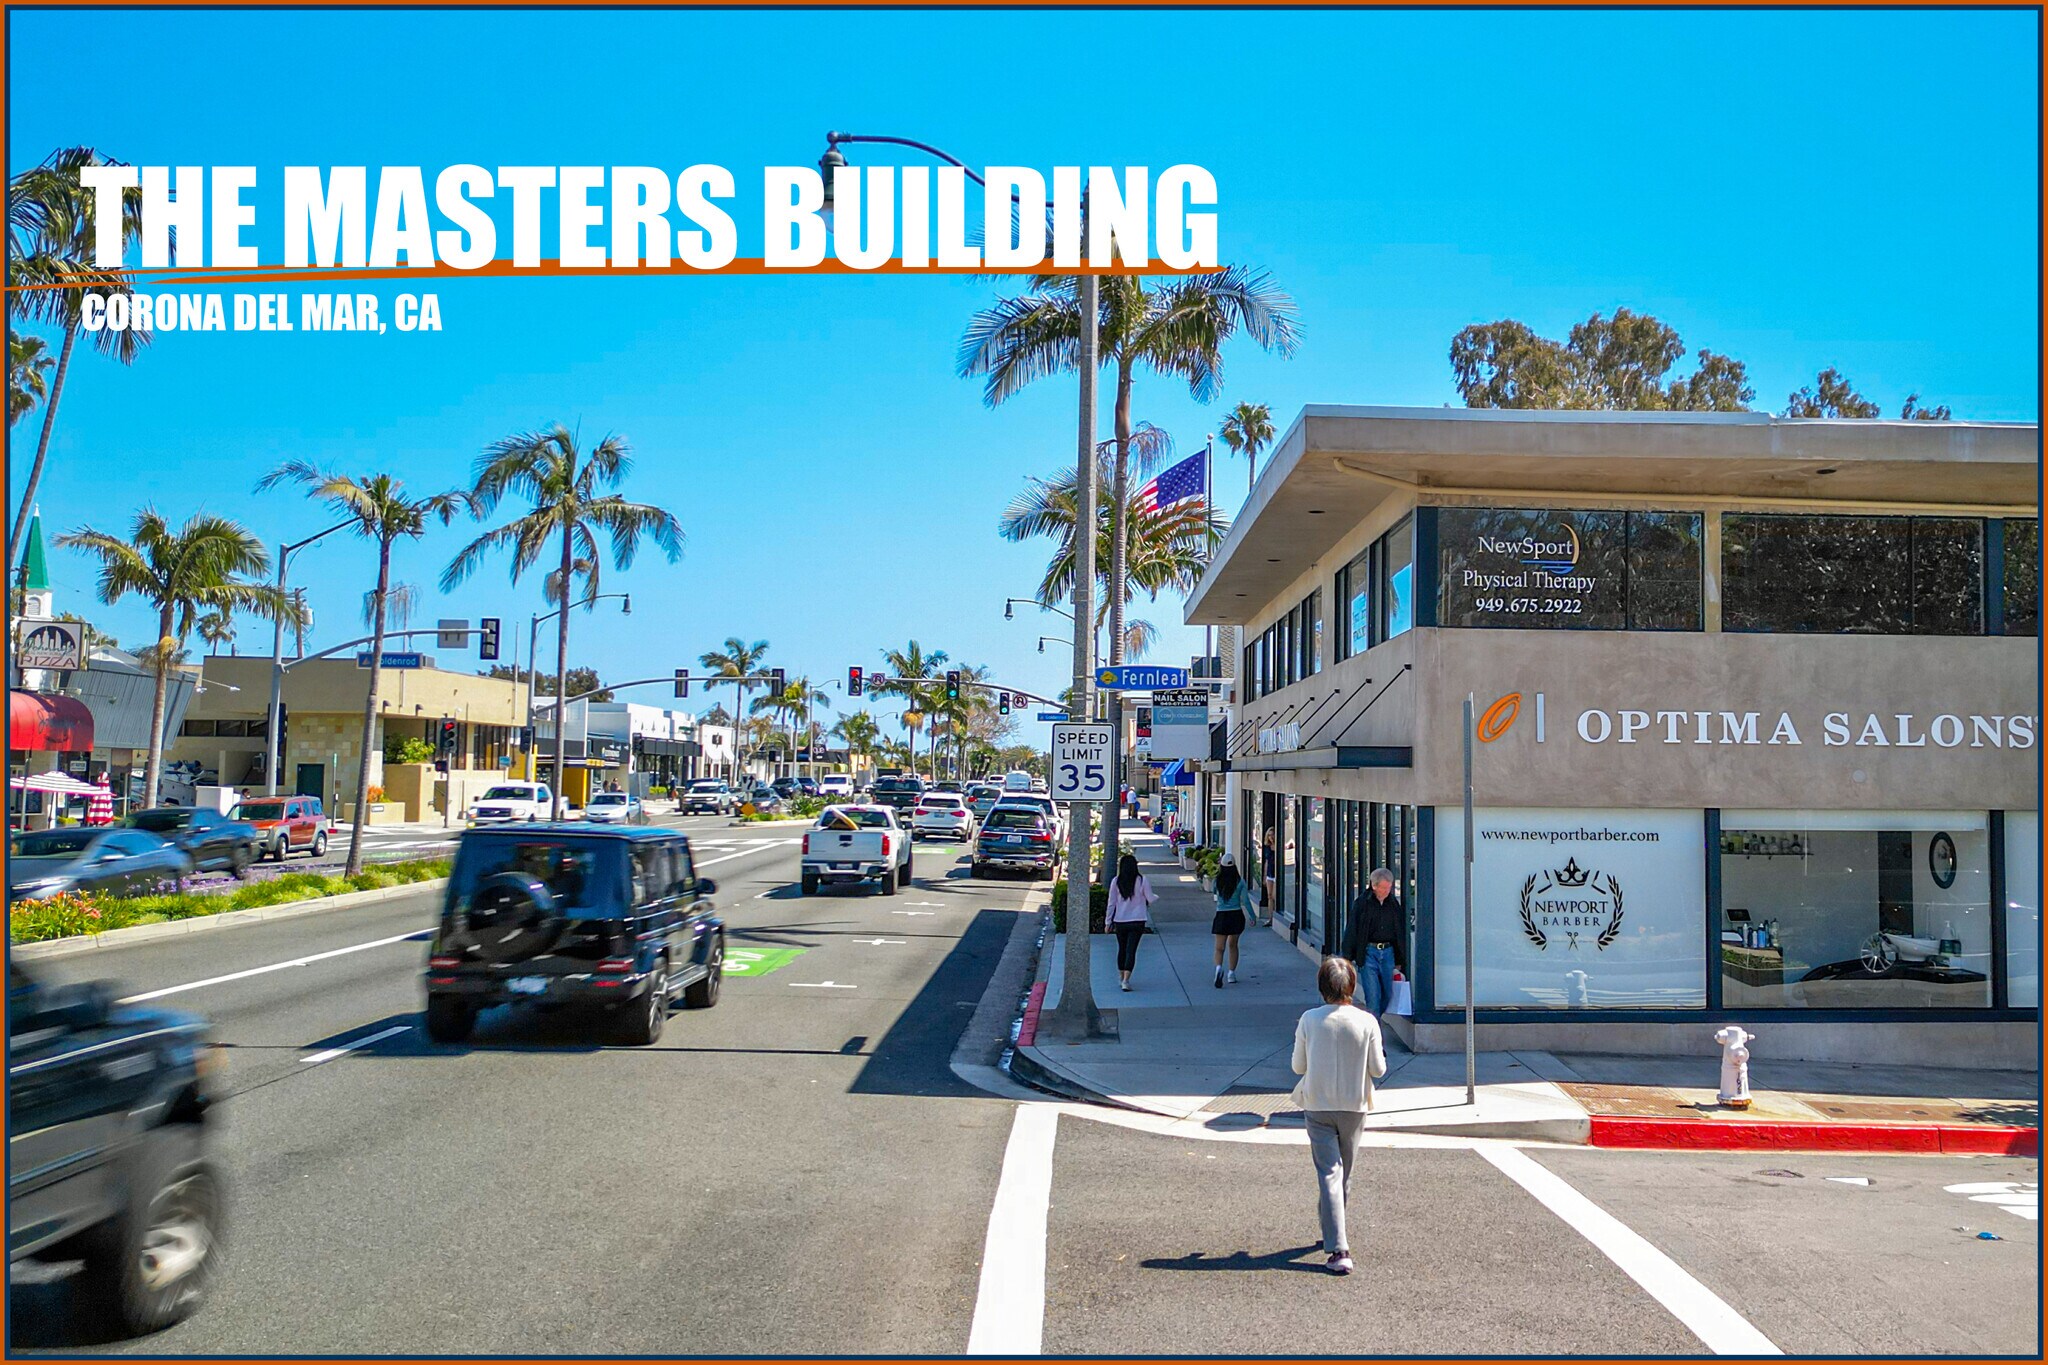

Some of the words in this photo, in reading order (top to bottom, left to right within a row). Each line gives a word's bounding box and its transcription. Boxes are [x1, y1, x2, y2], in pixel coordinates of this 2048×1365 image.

[1478, 537, 1573, 559] NewSport
[1463, 570, 1528, 591] Physical
[1533, 571, 1596, 593] Therapy
[1476, 598, 1582, 613] 949.675.2922
[20, 655, 76, 668] PIZZA
[379, 656, 417, 666] oldenrod
[1122, 669, 1185, 686] Fernleaf
[1154, 694, 1175, 702] NAIL
[1177, 694, 1207, 702] SALON
[1576, 709, 1803, 745] OPTIMA
[1822, 712, 2035, 749] SALONS
[1057, 732, 1109, 745] SPEED
[1062, 748, 1102, 760] LIMIT
[1058, 764, 1106, 792] 35
[1481, 828, 1660, 844] www.newportbarber.com
[1534, 900, 1608, 913] NEWPORT
[1542, 916, 1601, 926] BARBER
